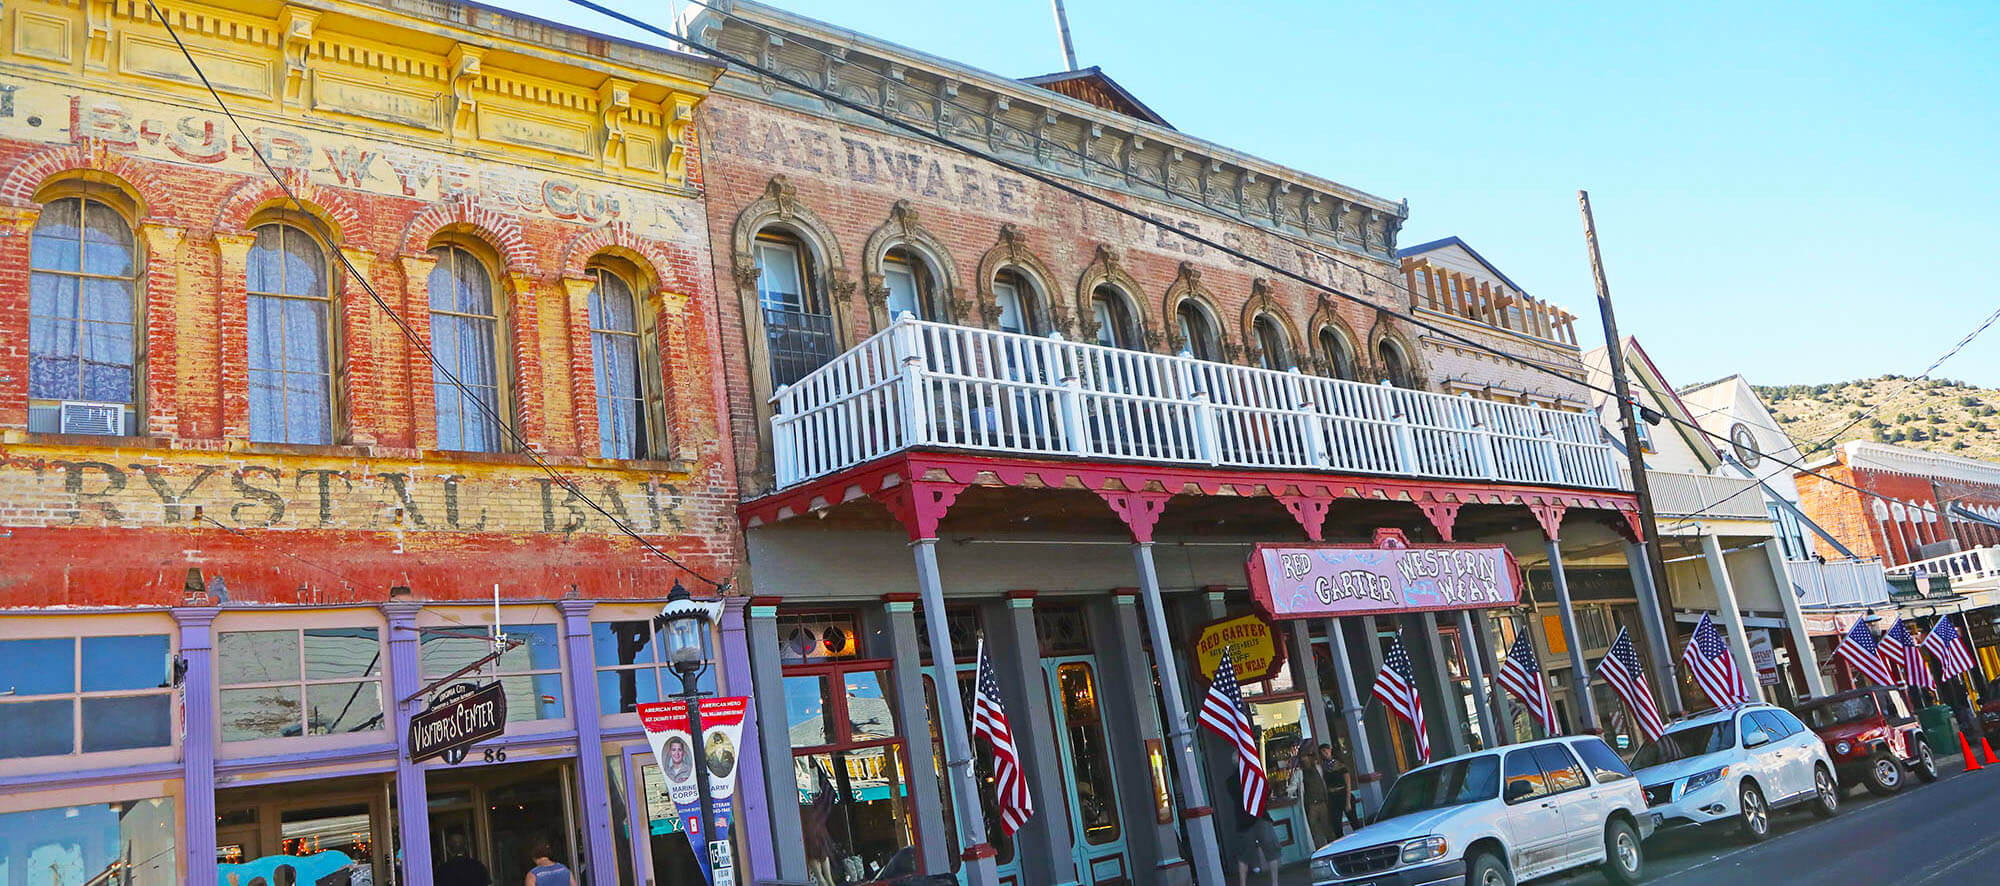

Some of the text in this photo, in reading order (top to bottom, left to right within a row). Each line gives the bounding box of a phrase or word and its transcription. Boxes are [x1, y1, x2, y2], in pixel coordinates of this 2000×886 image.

[531, 474, 690, 538] BAR
[1281, 552, 1399, 605] RED GARTER
[1396, 549, 1497, 586] WESTERN
[1438, 575, 1503, 605] WEAR
[1200, 623, 1267, 654] RED GARTER
[414, 701, 496, 752] VISITOR'S CENTER
[484, 747, 506, 763] 86
[672, 784, 697, 792] MARINE
[672, 791, 698, 800] CORPS
[711, 784, 730, 792] ARMY
